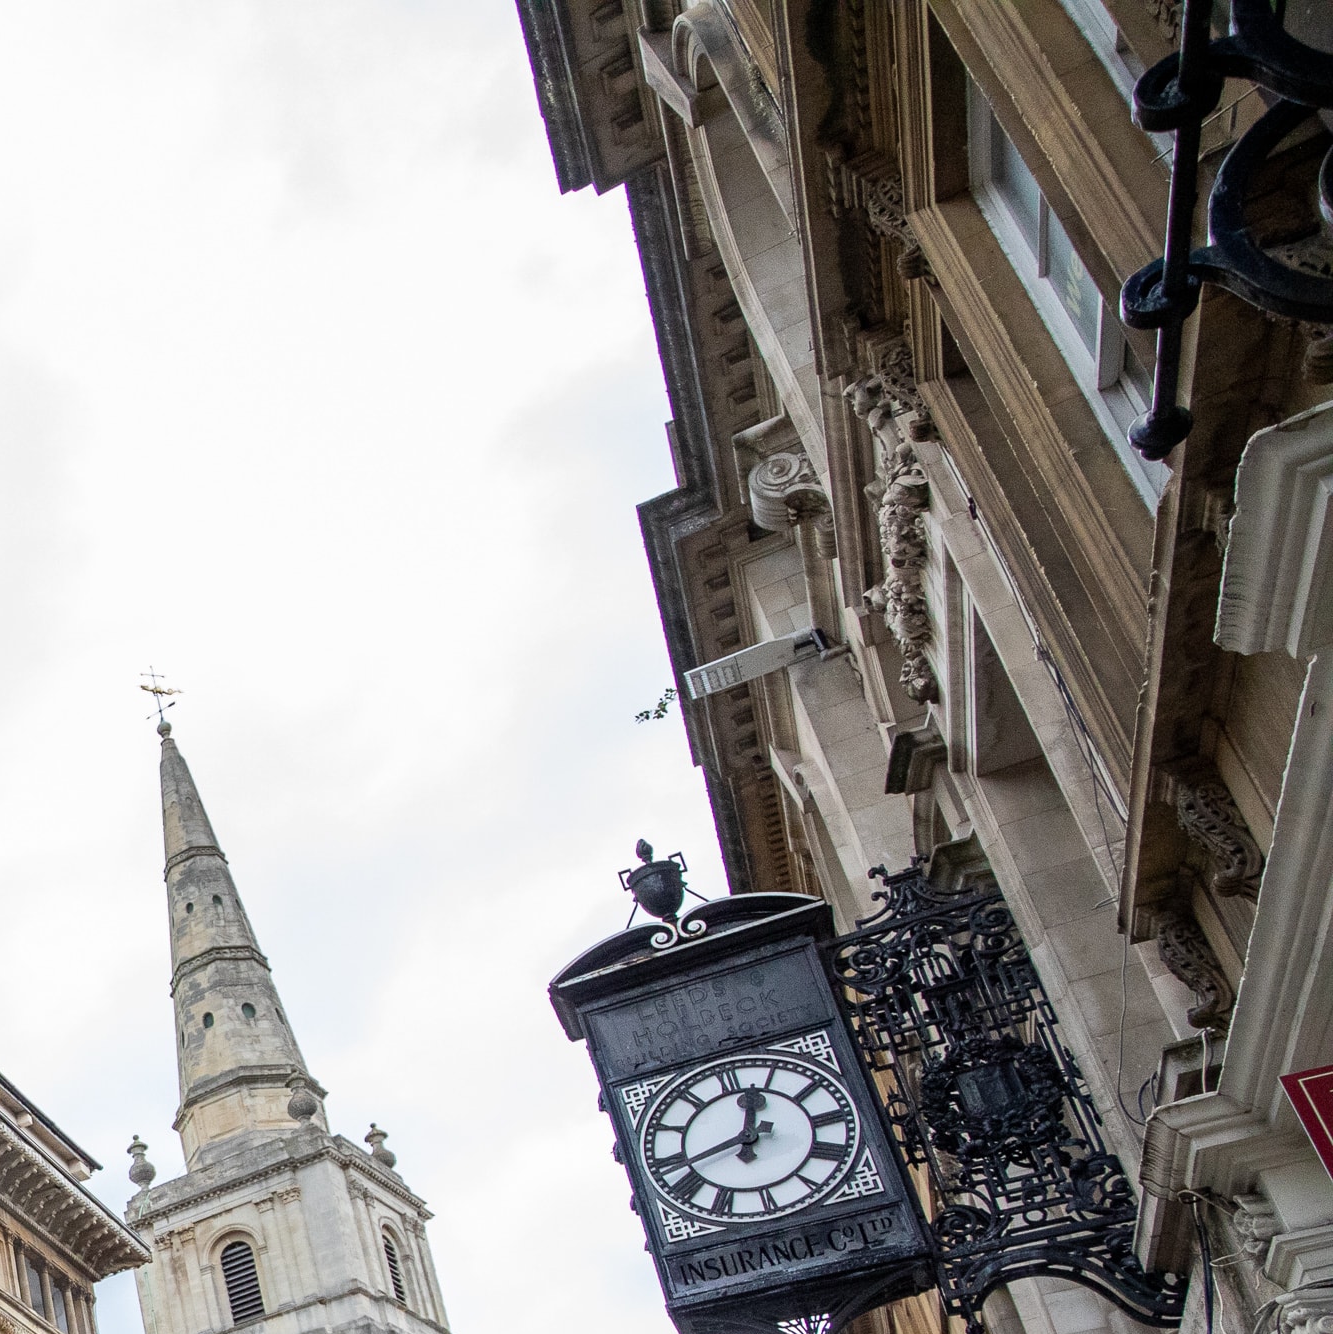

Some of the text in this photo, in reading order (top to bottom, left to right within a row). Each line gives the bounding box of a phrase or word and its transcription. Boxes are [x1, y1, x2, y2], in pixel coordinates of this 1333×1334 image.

[633, 989, 781, 1047] HOLBECK
[636, 980, 727, 1021] LEEDS
[681, 1233, 825, 1286] INSURANCE
